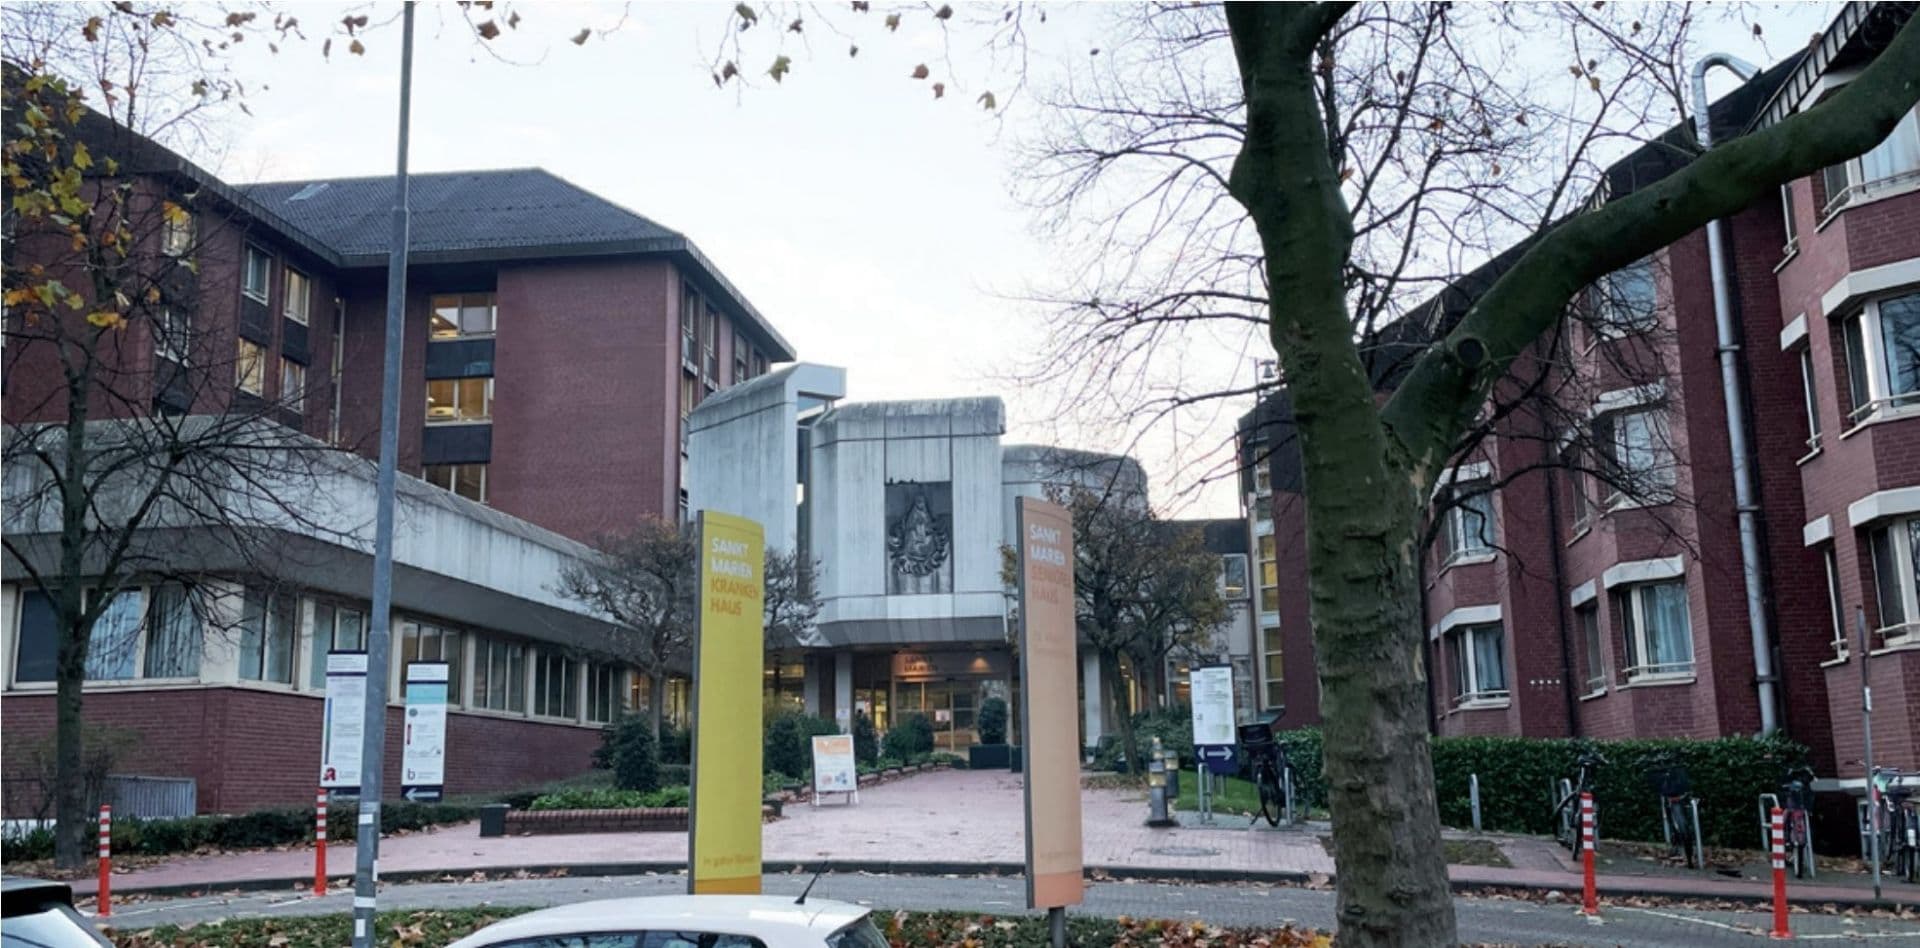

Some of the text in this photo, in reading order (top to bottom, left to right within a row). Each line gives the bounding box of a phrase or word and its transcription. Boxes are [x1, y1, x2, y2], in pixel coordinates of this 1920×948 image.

[711, 537, 750, 558] SANKT
[711, 557, 753, 578] MARIEN
[710, 598, 743, 616] HAUS
